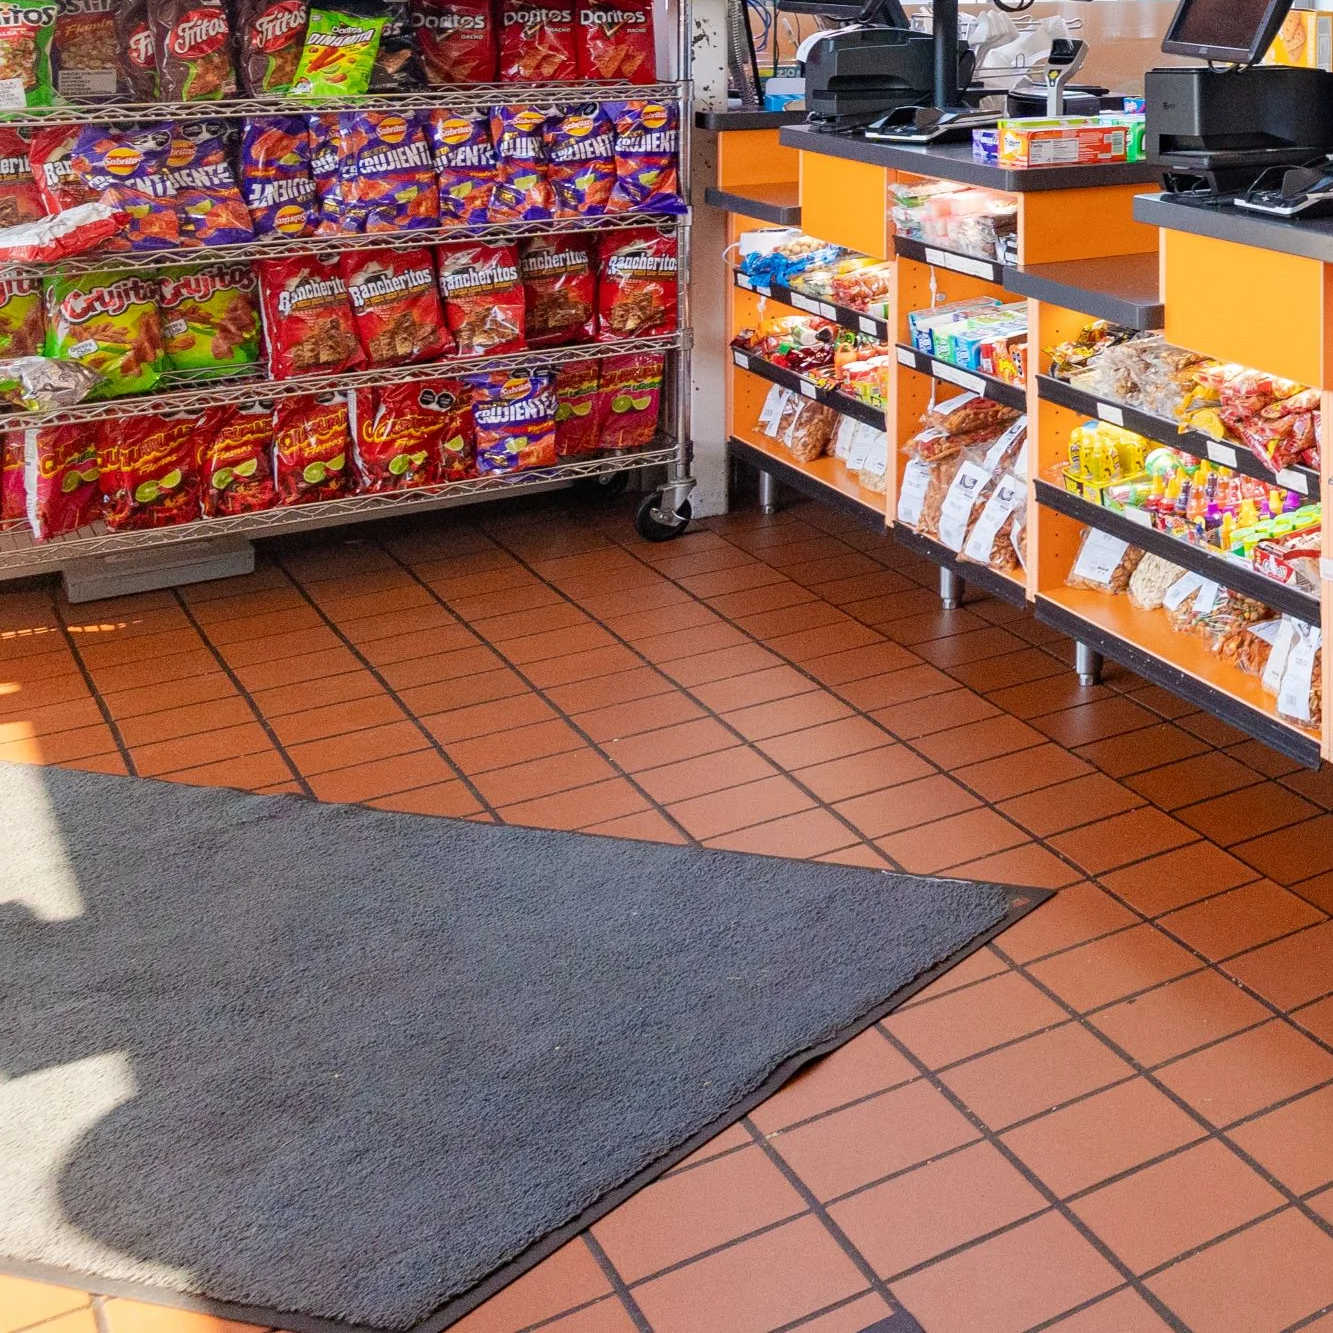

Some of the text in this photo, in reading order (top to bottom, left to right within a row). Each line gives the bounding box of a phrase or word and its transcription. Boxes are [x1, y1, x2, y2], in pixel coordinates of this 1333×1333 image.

[412, 13, 485, 32] Doritos
[504, 8, 572, 27] Doritos
[580, 9, 646, 27] Doritos
[173, 13, 228, 54] Fritos
[307, 30, 374, 48] DINAMITA
[331, 25, 362, 36] Doritos
[522, 250, 589, 271] ancheritos
[609, 251, 677, 275] Rancherito
[348, 269, 433, 307] Rancheritos
[439, 265, 519, 298] Rancheritos
[63, 278, 158, 323] Crujito
[213, 444, 253, 462] Flamas
